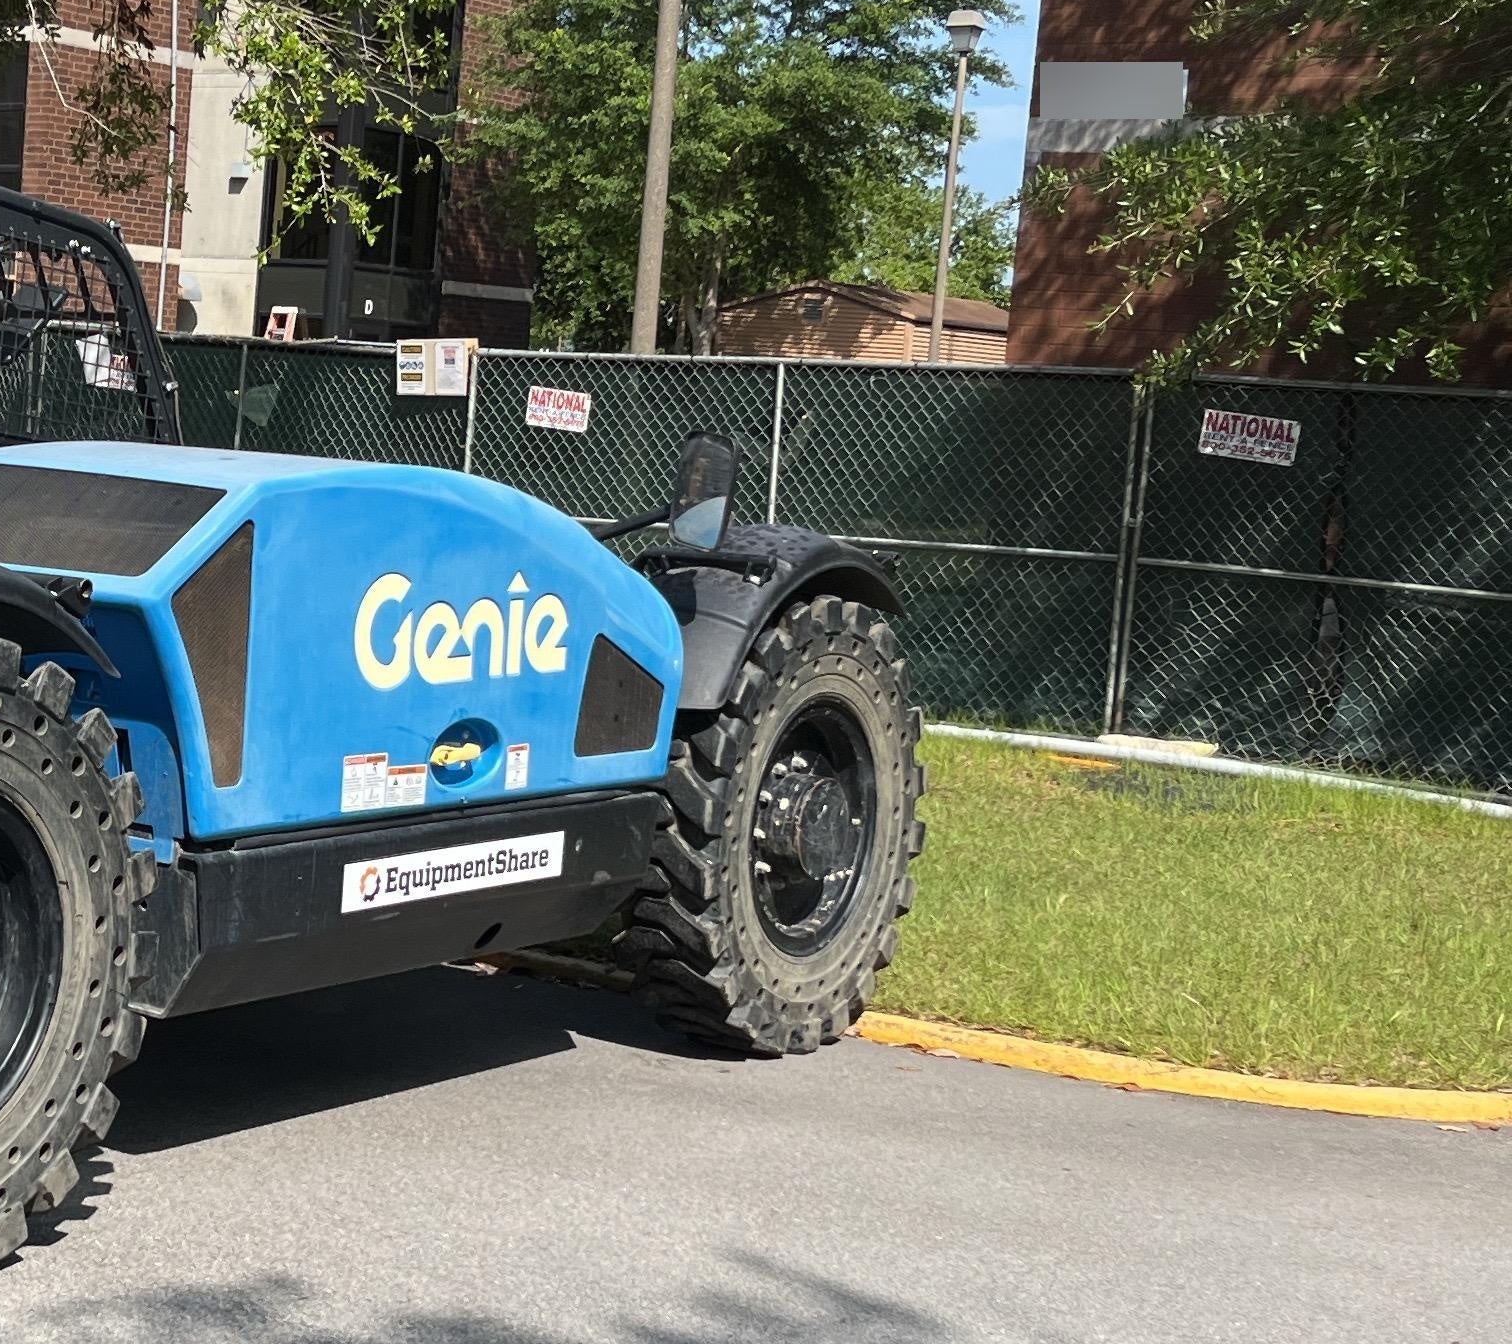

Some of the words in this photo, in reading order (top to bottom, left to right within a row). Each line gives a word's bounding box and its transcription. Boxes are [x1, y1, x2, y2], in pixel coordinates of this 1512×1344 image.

[364, 299, 374, 315] D
[529, 388, 586, 413] NATIONAL
[1205, 412, 1295, 443] NATIONAL
[353, 570, 569, 692] Genie
[384, 848, 550, 896] EquipmentShare
